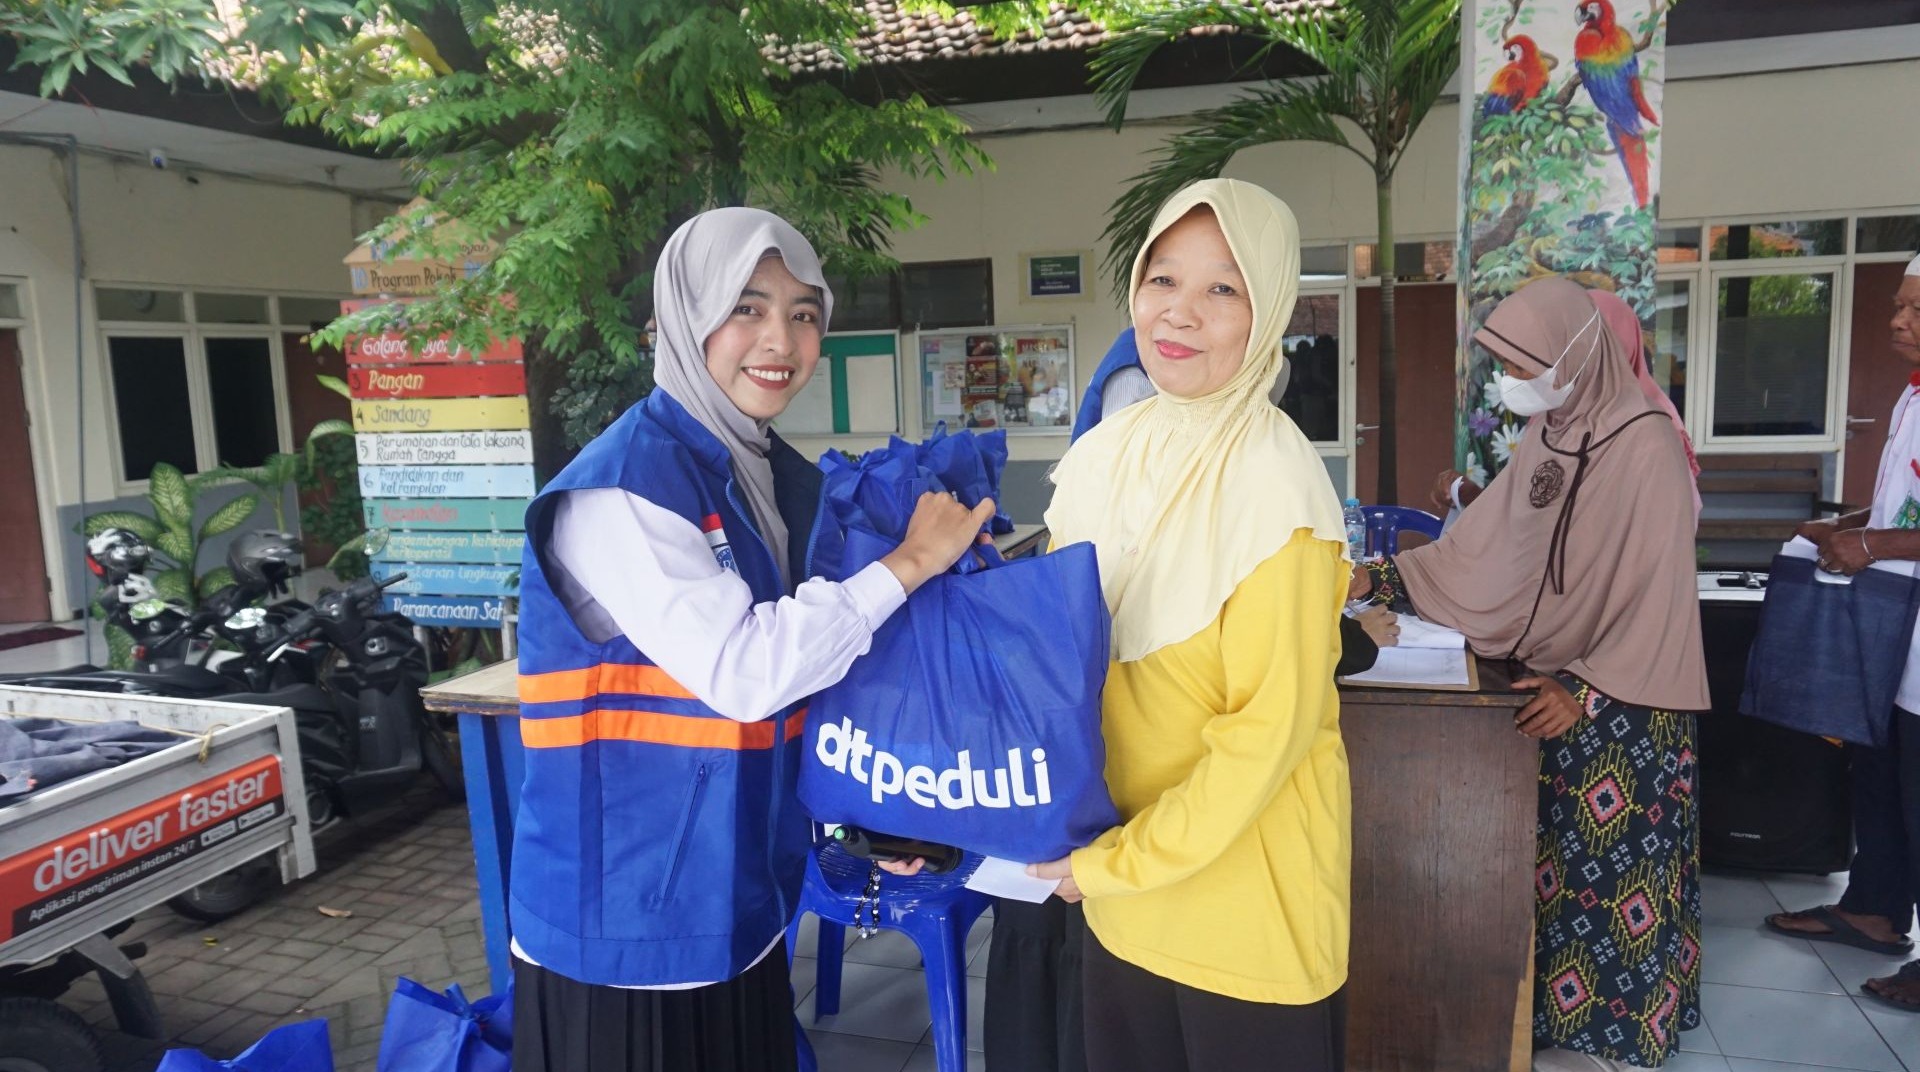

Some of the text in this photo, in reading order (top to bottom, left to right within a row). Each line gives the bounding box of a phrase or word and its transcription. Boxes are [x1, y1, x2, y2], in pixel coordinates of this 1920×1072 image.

[370, 269, 420, 292] Program
[368, 369, 424, 395] Pangan
[356, 405, 432, 428] 4 Sandang
[360, 440, 369, 459] 5
[376, 449, 413, 462] Rumah
[364, 472, 374, 488] 6
[441, 468, 464, 483] dan
[816, 715, 1052, 810] dtpeduli
[33, 769, 272, 892] deliver faster
[29, 839, 196, 922] Aplikasi pengiriman instan 24/7
